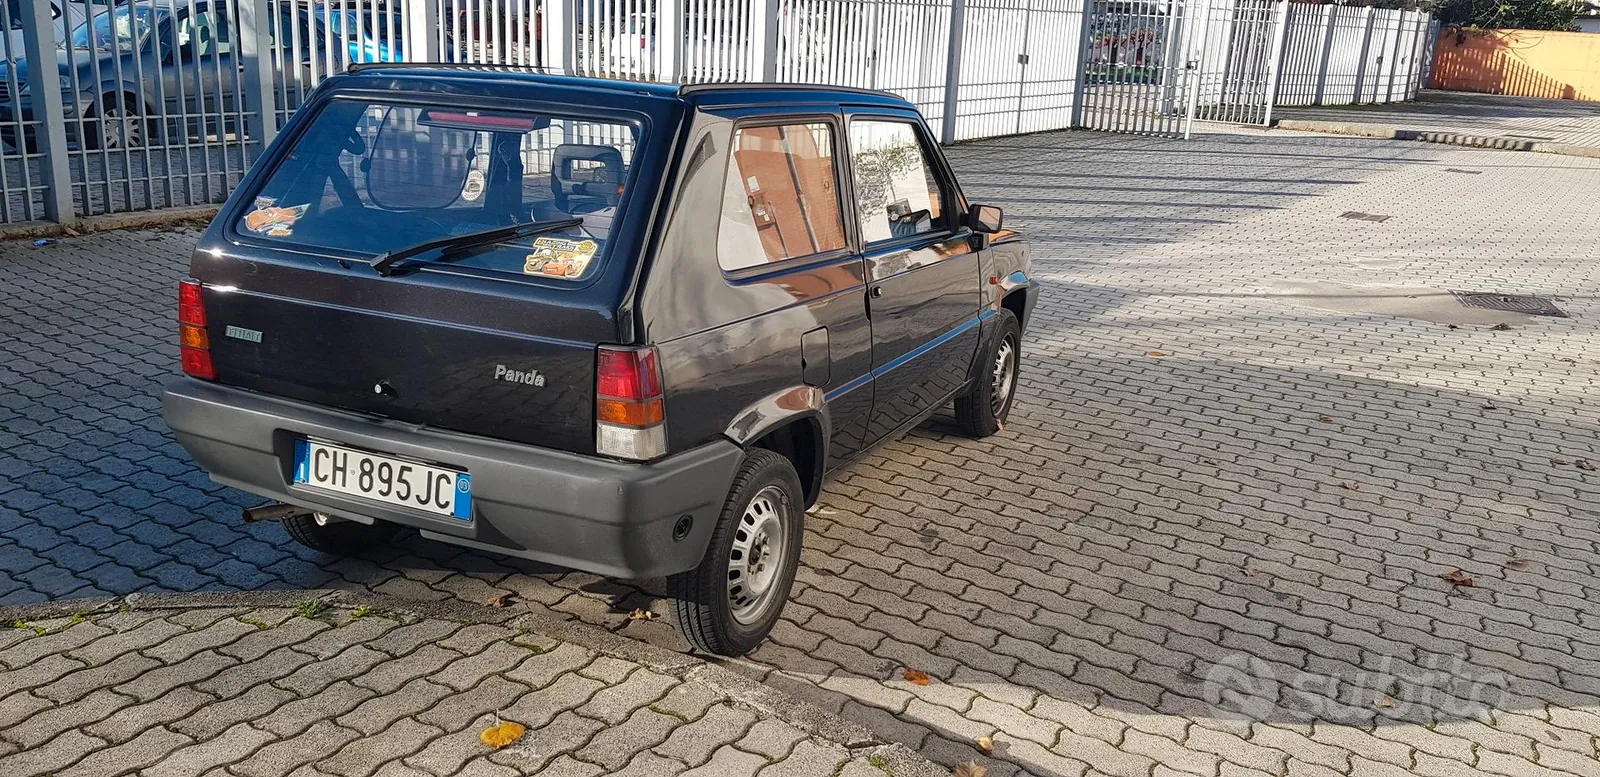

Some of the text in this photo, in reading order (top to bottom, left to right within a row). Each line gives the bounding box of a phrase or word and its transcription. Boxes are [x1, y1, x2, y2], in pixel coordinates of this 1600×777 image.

[228, 326, 262, 341] FIAT
[494, 364, 545, 387] Panda
[314, 448, 348, 487] CH
